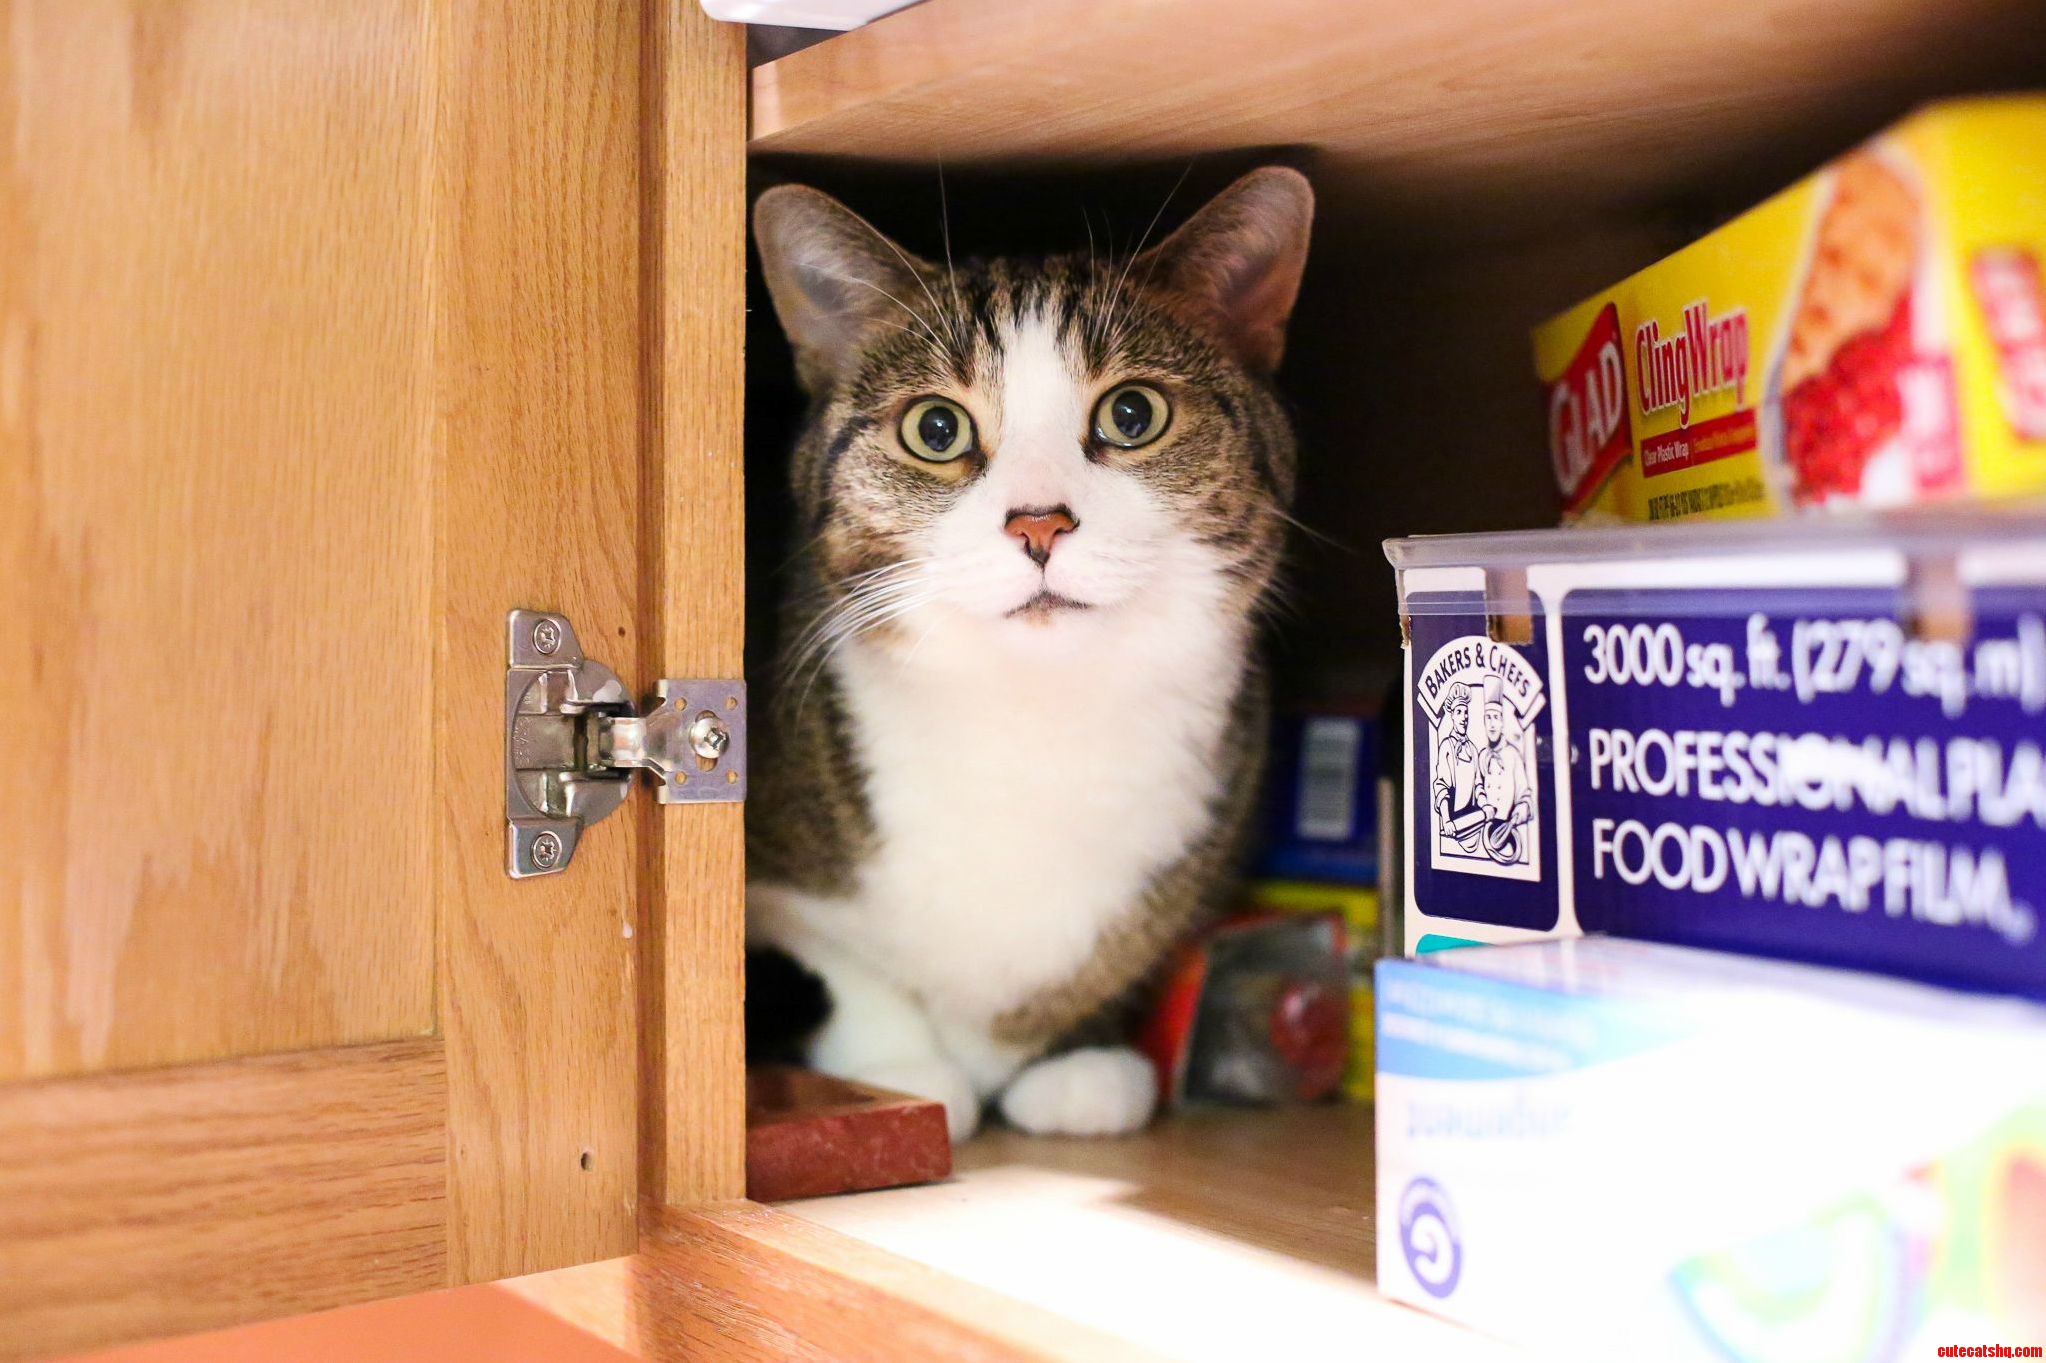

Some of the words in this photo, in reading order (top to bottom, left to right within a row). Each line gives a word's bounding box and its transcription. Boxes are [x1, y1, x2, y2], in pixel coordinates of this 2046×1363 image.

[1551, 341, 1623, 497] GLAD
[1425, 646, 1472, 700] BAKERS
[1475, 642, 1486, 668] &
[1489, 645, 1530, 697] CHEFS
[1583, 622, 1684, 687] 3000
[1588, 727, 1949, 822] PROFESSIONAL
[1592, 817, 1729, 893] FOOD
[1725, 826, 1883, 914] WRAP
